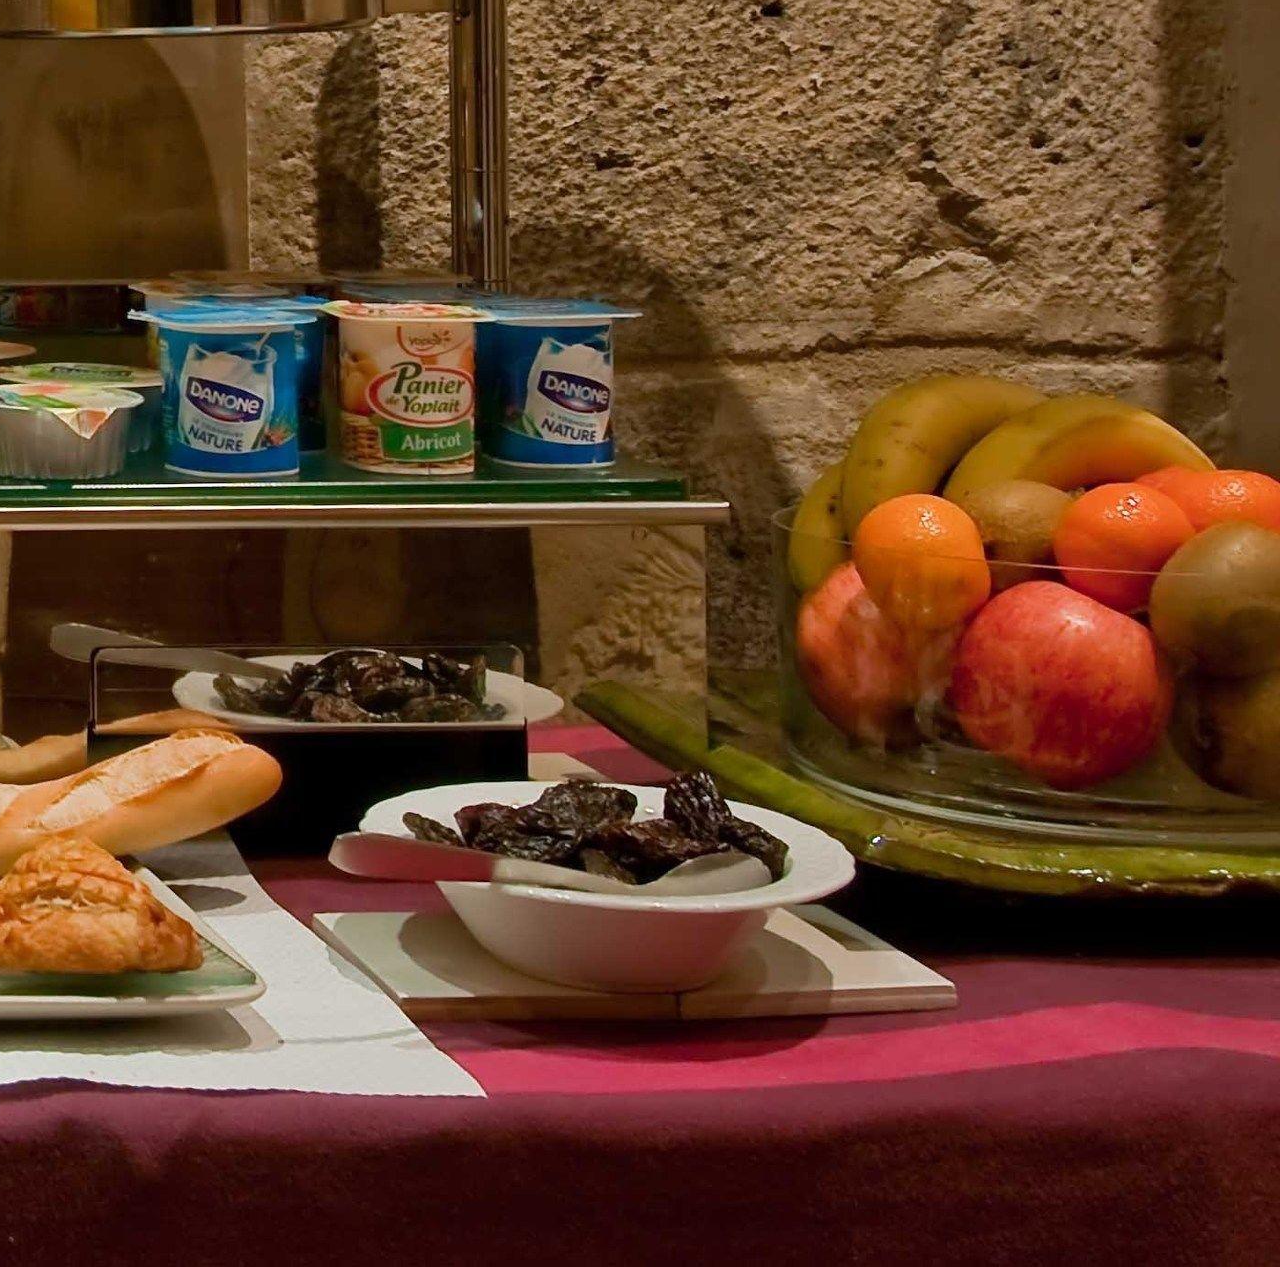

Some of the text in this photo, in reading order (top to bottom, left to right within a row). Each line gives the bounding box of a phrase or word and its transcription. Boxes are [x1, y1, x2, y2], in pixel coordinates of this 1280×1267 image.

[390, 361, 465, 394] Panier
[402, 395, 460, 415] Yoplait
[189, 424, 243, 452] NATURE
[401, 432, 461, 451] Abricot
[541, 417, 597, 442] NATURE
